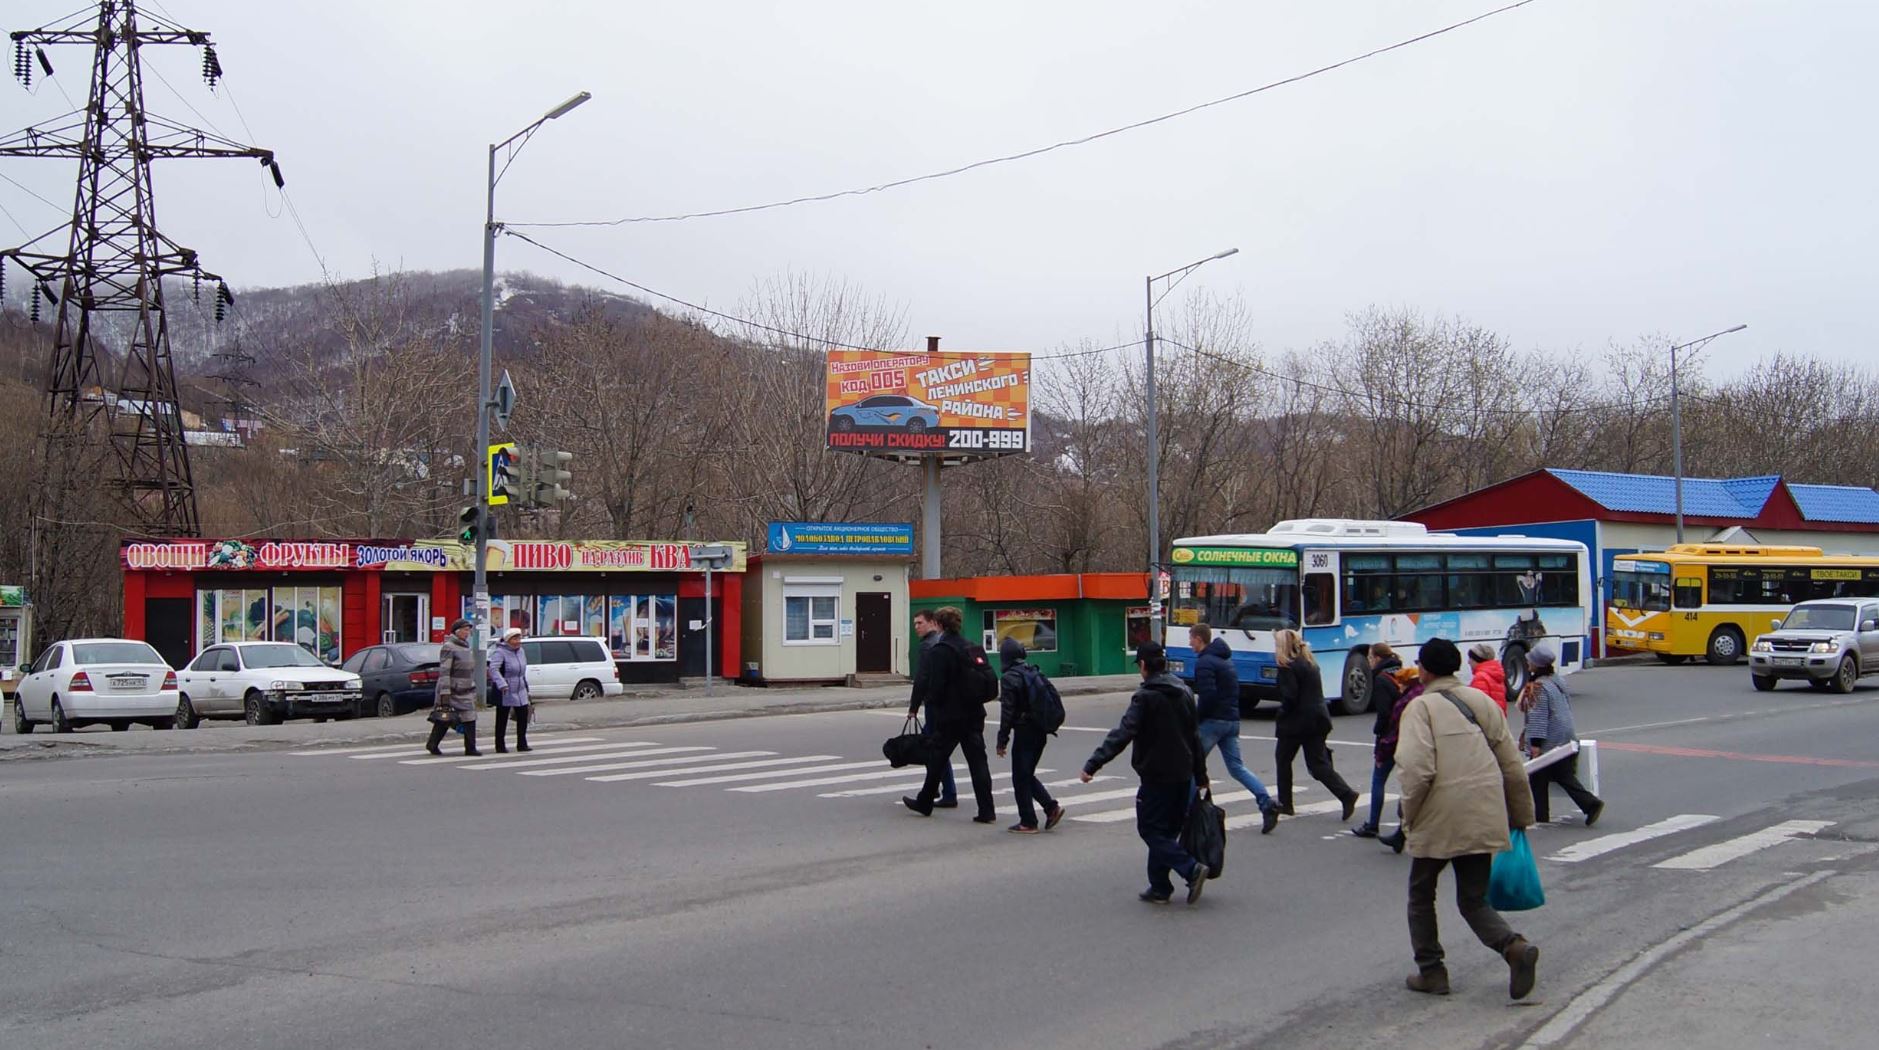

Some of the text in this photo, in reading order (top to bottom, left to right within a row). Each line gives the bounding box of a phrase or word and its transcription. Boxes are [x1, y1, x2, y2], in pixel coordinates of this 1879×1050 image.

[871, 370, 906, 391] 005
[915, 359, 977, 388] ТАКСИ
[927, 373, 1018, 401] ЛЕНИНСКОГО
[941, 399, 1003, 419] РАЙОНА
[830, 430, 1024, 449] ПОЛУЧИ СКИДКУ! 200-999
[127, 543, 349, 570] ОВОЩИ ФРУКТЫ
[356, 545, 447, 568] ЗОЛОТОЙ ЯКОРЬ
[513, 543, 707, 570] ПИВО НА РАЗЛИВ КВА
[1197, 550, 1261, 563] СОЛНЕЧНЫЕ
[1264, 551, 1297, 564] ОКНА
[1684, 612, 1698, 621] 414
